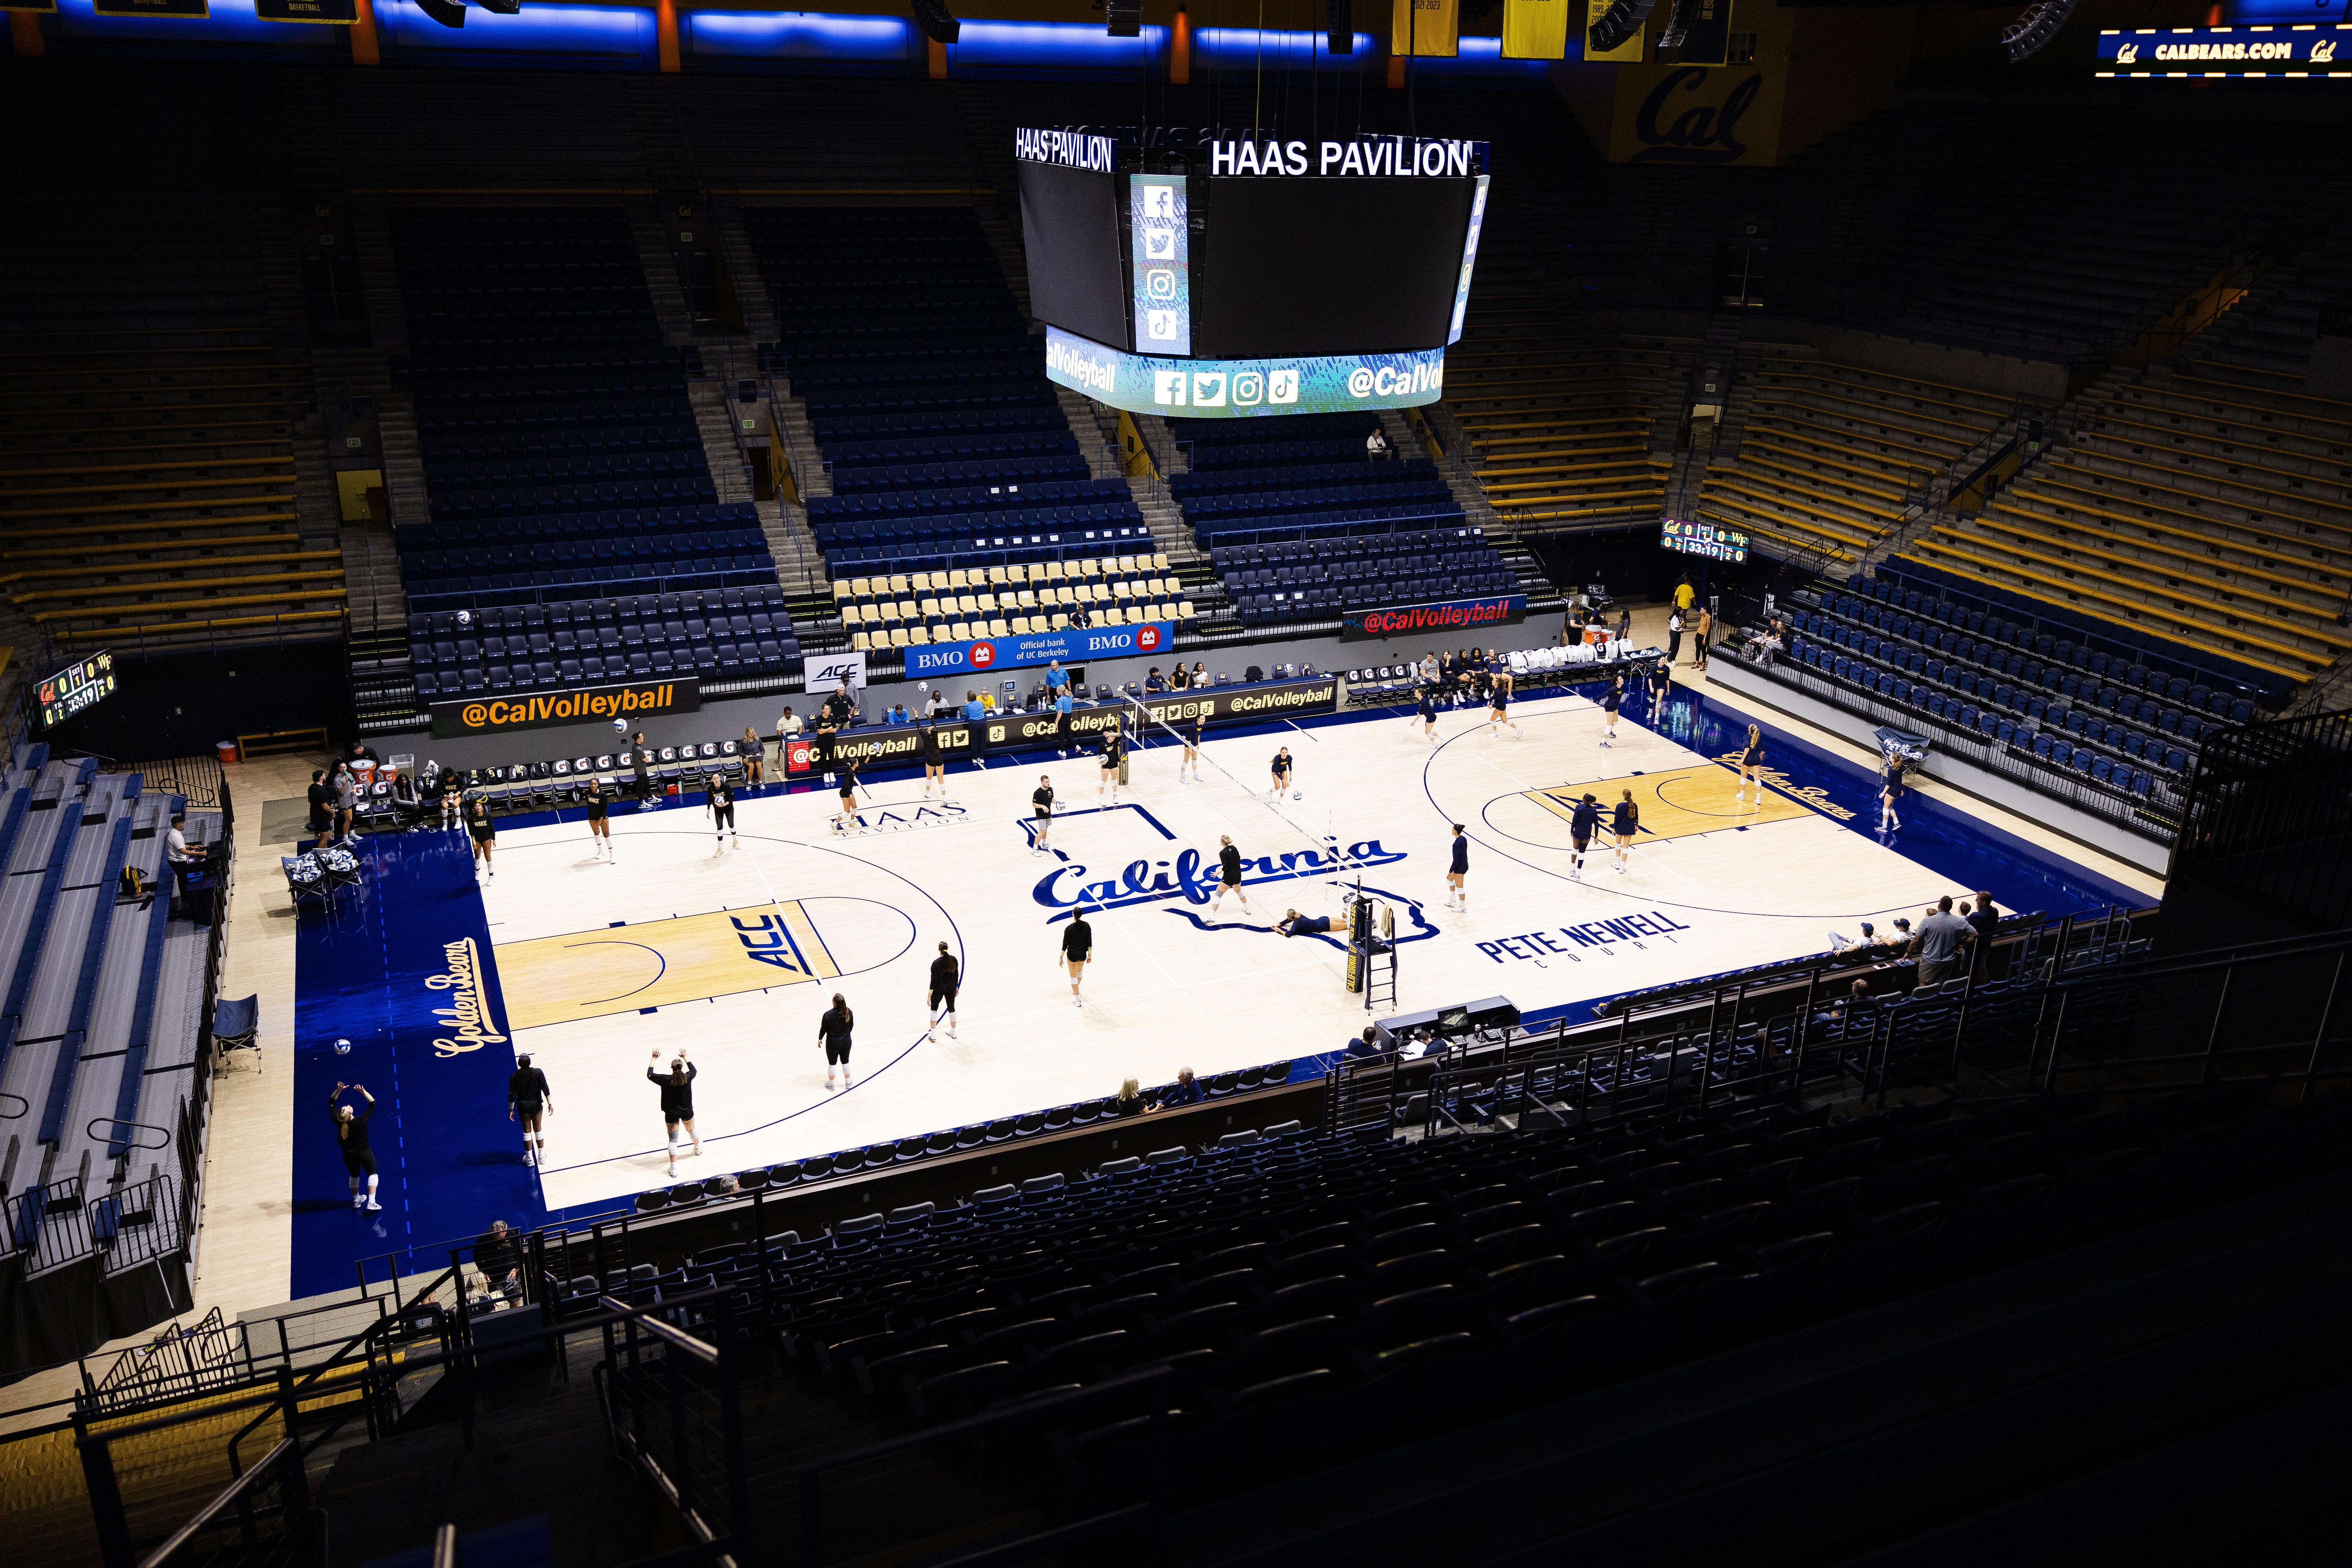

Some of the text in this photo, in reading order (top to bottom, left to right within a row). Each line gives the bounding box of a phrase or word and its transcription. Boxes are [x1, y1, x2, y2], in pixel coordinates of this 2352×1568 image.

[289, 3, 321, 11] BASKETBALL
[1426, 0, 1440, 10] 2023
[2116, 43, 2139, 64] Cal
[2155, 43, 2292, 60] CALBEARS.COM
[2308, 40, 2337, 63] Cal
[1630, 66, 1761, 165] Cal
[1016, 127, 1112, 172] HAAS PAVILION
[1212, 141, 1468, 176] HAAS PAVILION
[679, 205, 692, 217] Cal
[1046, 340, 1116, 393] alVolleyball
[348, 439, 360, 447] EXIT
[1664, 520, 1681, 534] Cal
[1685, 524, 1693, 536] 0
[1664, 537, 1672, 548] 0
[1717, 531, 1726, 542] 0
[1731, 532, 1748, 547] WF
[1675, 543, 1681, 551] 2
[1688, 542, 1719, 557] 33:19
[1725, 552, 1731, 561] 2
[1735, 550, 1744, 562] 0
[1364, 600, 1509, 633] @CalVolleyball
[1020, 639, 1065, 651] Official bank
[1088, 634, 1131, 651] BMO
[918, 651, 964, 669] BMO
[1016, 648, 1069, 660] of UC Berkeley
[97, 653, 112, 671] WF
[72, 667, 81, 676] SET
[87, 662, 95, 678] 0
[815, 663, 860, 679] ACC
[1349, 670, 1358, 680] G
[1365, 669, 1373, 679] G
[1380, 667, 1388, 677] G
[1396, 666, 1403, 675] G
[59, 677, 67, 693] 0
[75, 675, 80, 686] 1
[107, 676, 114, 690] 0
[99, 685, 105, 697] 2
[462, 684, 673, 728] @CalVolleyball
[1231, 687, 1333, 711] @CalVolleyball
[46, 709, 54, 725] 0
[661, 747, 673, 760] G
[682, 745, 693, 757] G
[703, 742, 714, 755] G
[723, 740, 734, 753] G
[576, 757, 588, 770] G
[598, 755, 609, 768] G
[620, 753, 632, 765] G
[555, 760, 567, 773] G
[359, 772, 368, 781] G
[376, 782, 388, 795] G
[1787, 786, 1857, 819] Bears
[830, 802, 967, 831] HAAS
[841, 815, 971, 837] PAVILION
[1032, 836, 1408, 919] California
[729, 915, 799, 973] ACC
[1474, 910, 1691, 964] PETE NEWELL
[1534, 935, 1679, 969] COURT
[1347, 954, 1357, 993] CALIFORNIA
[424, 937, 507, 1058] Golden Bears
